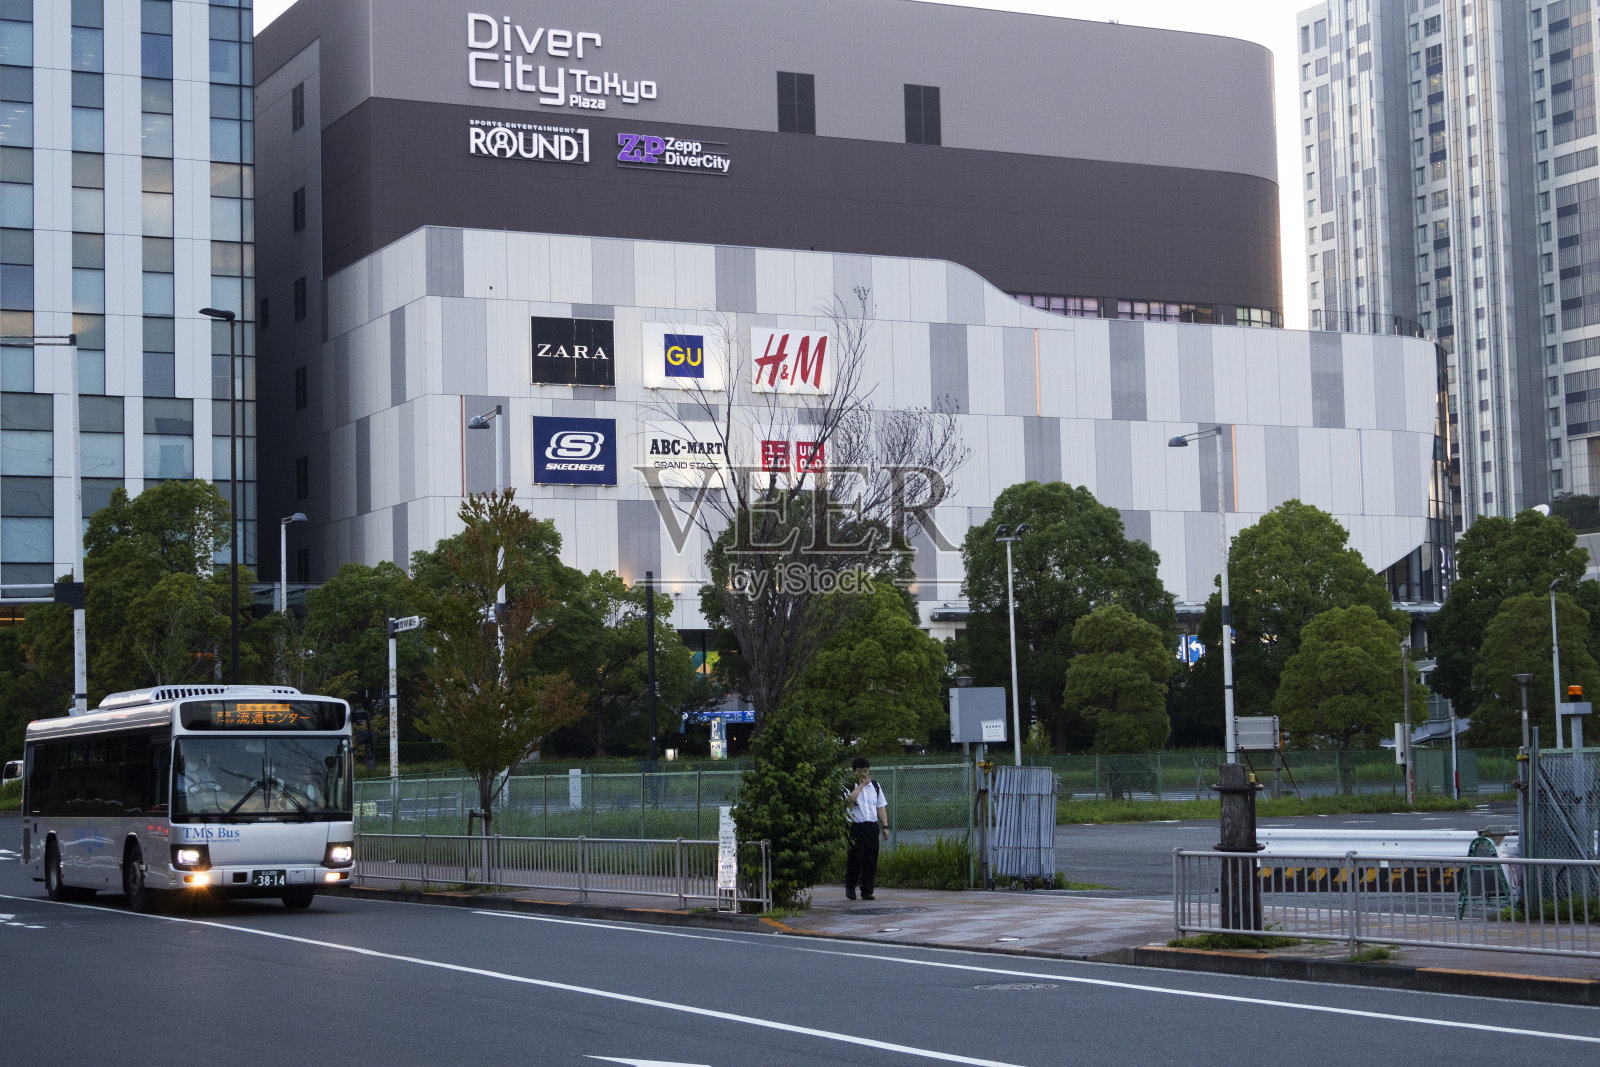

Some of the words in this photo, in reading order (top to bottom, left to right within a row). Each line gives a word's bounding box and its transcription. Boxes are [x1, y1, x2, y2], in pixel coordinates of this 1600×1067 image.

[467, 12, 602, 59] Diver
[468, 51, 566, 106] City
[569, 94, 607, 110] Plaza
[469, 119, 503, 128] SPORTS
[505, 122, 576, 134] ENTERTAINMENT
[617, 132, 665, 164] ZP
[665, 137, 702, 155] Zepp
[665, 151, 731, 173] DiverCity
[536, 343, 610, 361] ZARA
[666, 345, 702, 367] GU
[754, 333, 828, 389] H&M
[650, 438, 723, 455] ABC-MART
[545, 462, 606, 472] SKECHERS
[653, 460, 688, 469] GRAND
[236, 711, 311, 725] 流通センター
[183, 827, 214, 839] TMS
[217, 827, 240, 838] Bus
[258, 875, 285, 886] 38-14
